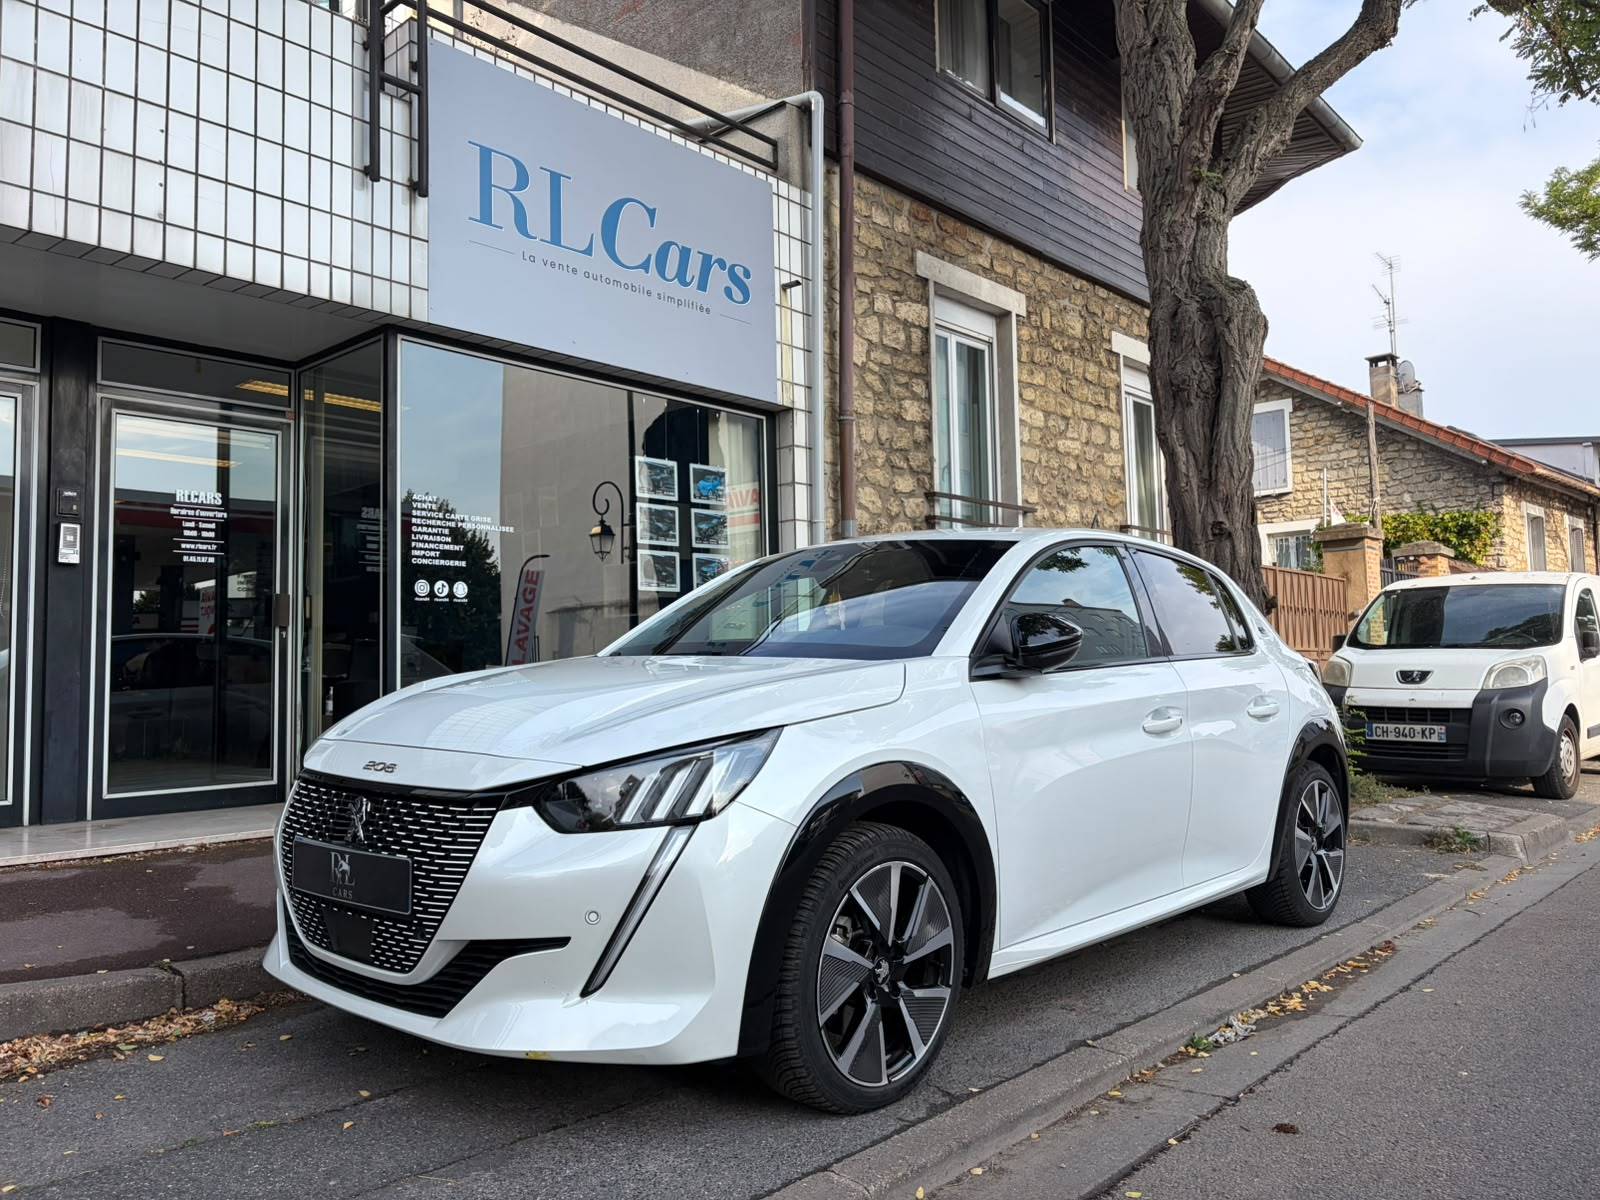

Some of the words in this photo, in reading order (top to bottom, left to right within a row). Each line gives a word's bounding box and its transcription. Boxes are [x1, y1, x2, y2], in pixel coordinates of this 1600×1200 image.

[467, 140, 752, 306] RLCars
[521, 250, 536, 265] La
[542, 257, 578, 275] vente
[583, 269, 653, 298] automobile
[656, 289, 711, 315] simplifiée
[411, 494, 437, 502] ACHAT
[411, 502, 437, 510] VENTE
[411, 510, 443, 518] SERVICE
[445, 513, 469, 521] CARTE
[470, 515, 492, 523] GRISE
[411, 518, 456, 528] RECHERCHE
[411, 526, 450, 535] GARANTIE
[411, 534, 452, 543] LIVRAISON
[411, 542, 465, 552] FINANCEMENT
[411, 550, 441, 558] IMPORT
[411, 558, 467, 568] CONCIERGERIE
[511, 569, 541, 666] LAVAGE
[1374, 725, 1436, 740] CH-940-KP
[332, 887, 353, 900] CARS
